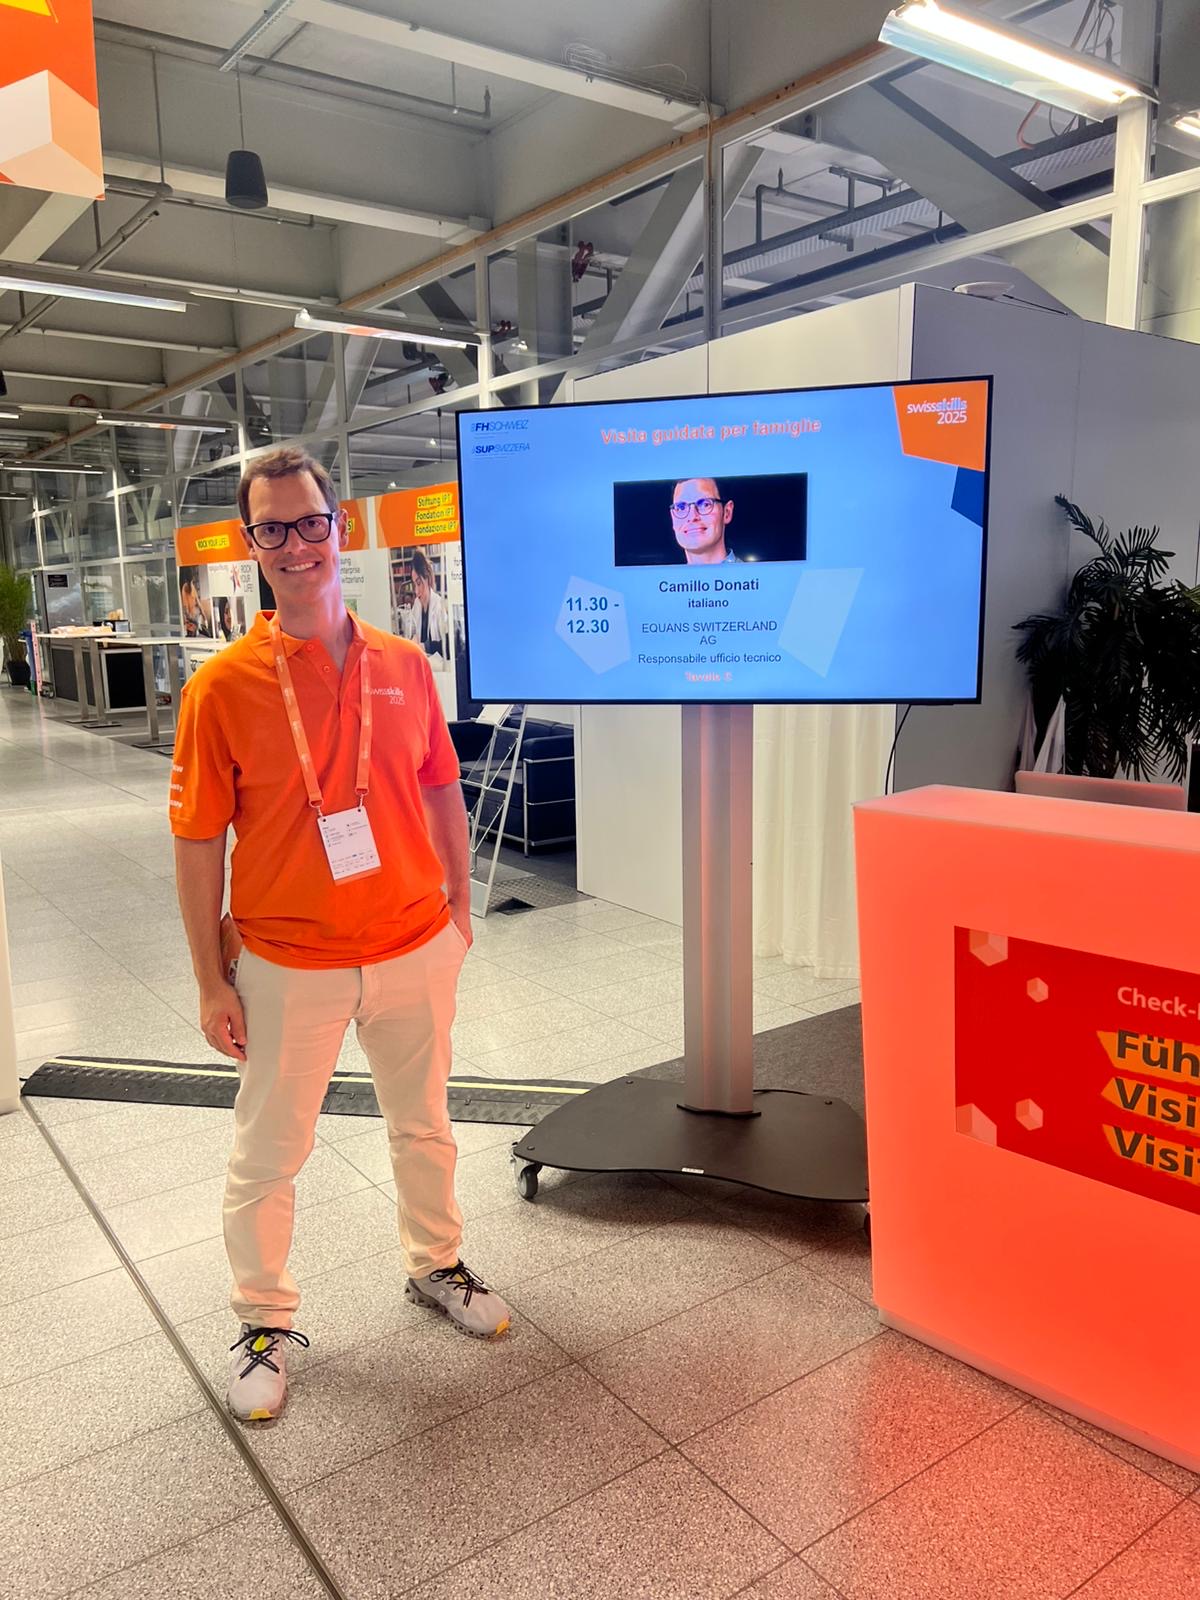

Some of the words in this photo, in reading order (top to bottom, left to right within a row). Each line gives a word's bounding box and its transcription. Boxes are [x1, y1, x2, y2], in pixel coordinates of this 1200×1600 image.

[907, 397, 968, 414] swissskills
[937, 410, 968, 425] 2025
[601, 429, 646, 445] Visita
[653, 424, 705, 446] guidata
[710, 424, 748, 441] per
[753, 418, 822, 440] famiglie
[659, 581, 710, 594] Camillo
[714, 578, 760, 592] Donati
[566, 596, 608, 612] 11.30
[688, 599, 729, 609] italiano
[566, 619, 610, 634] 12.30
[641, 623, 690, 634] EQUANS
[692, 620, 778, 633] SWITZERLAND
[699, 635, 718, 646] AG
[638, 653, 708, 665] Responsabile
[710, 652, 741, 663] ufficio
[743, 651, 782, 663] tecnico
[1113, 1126, 1200, 1178] Visi
